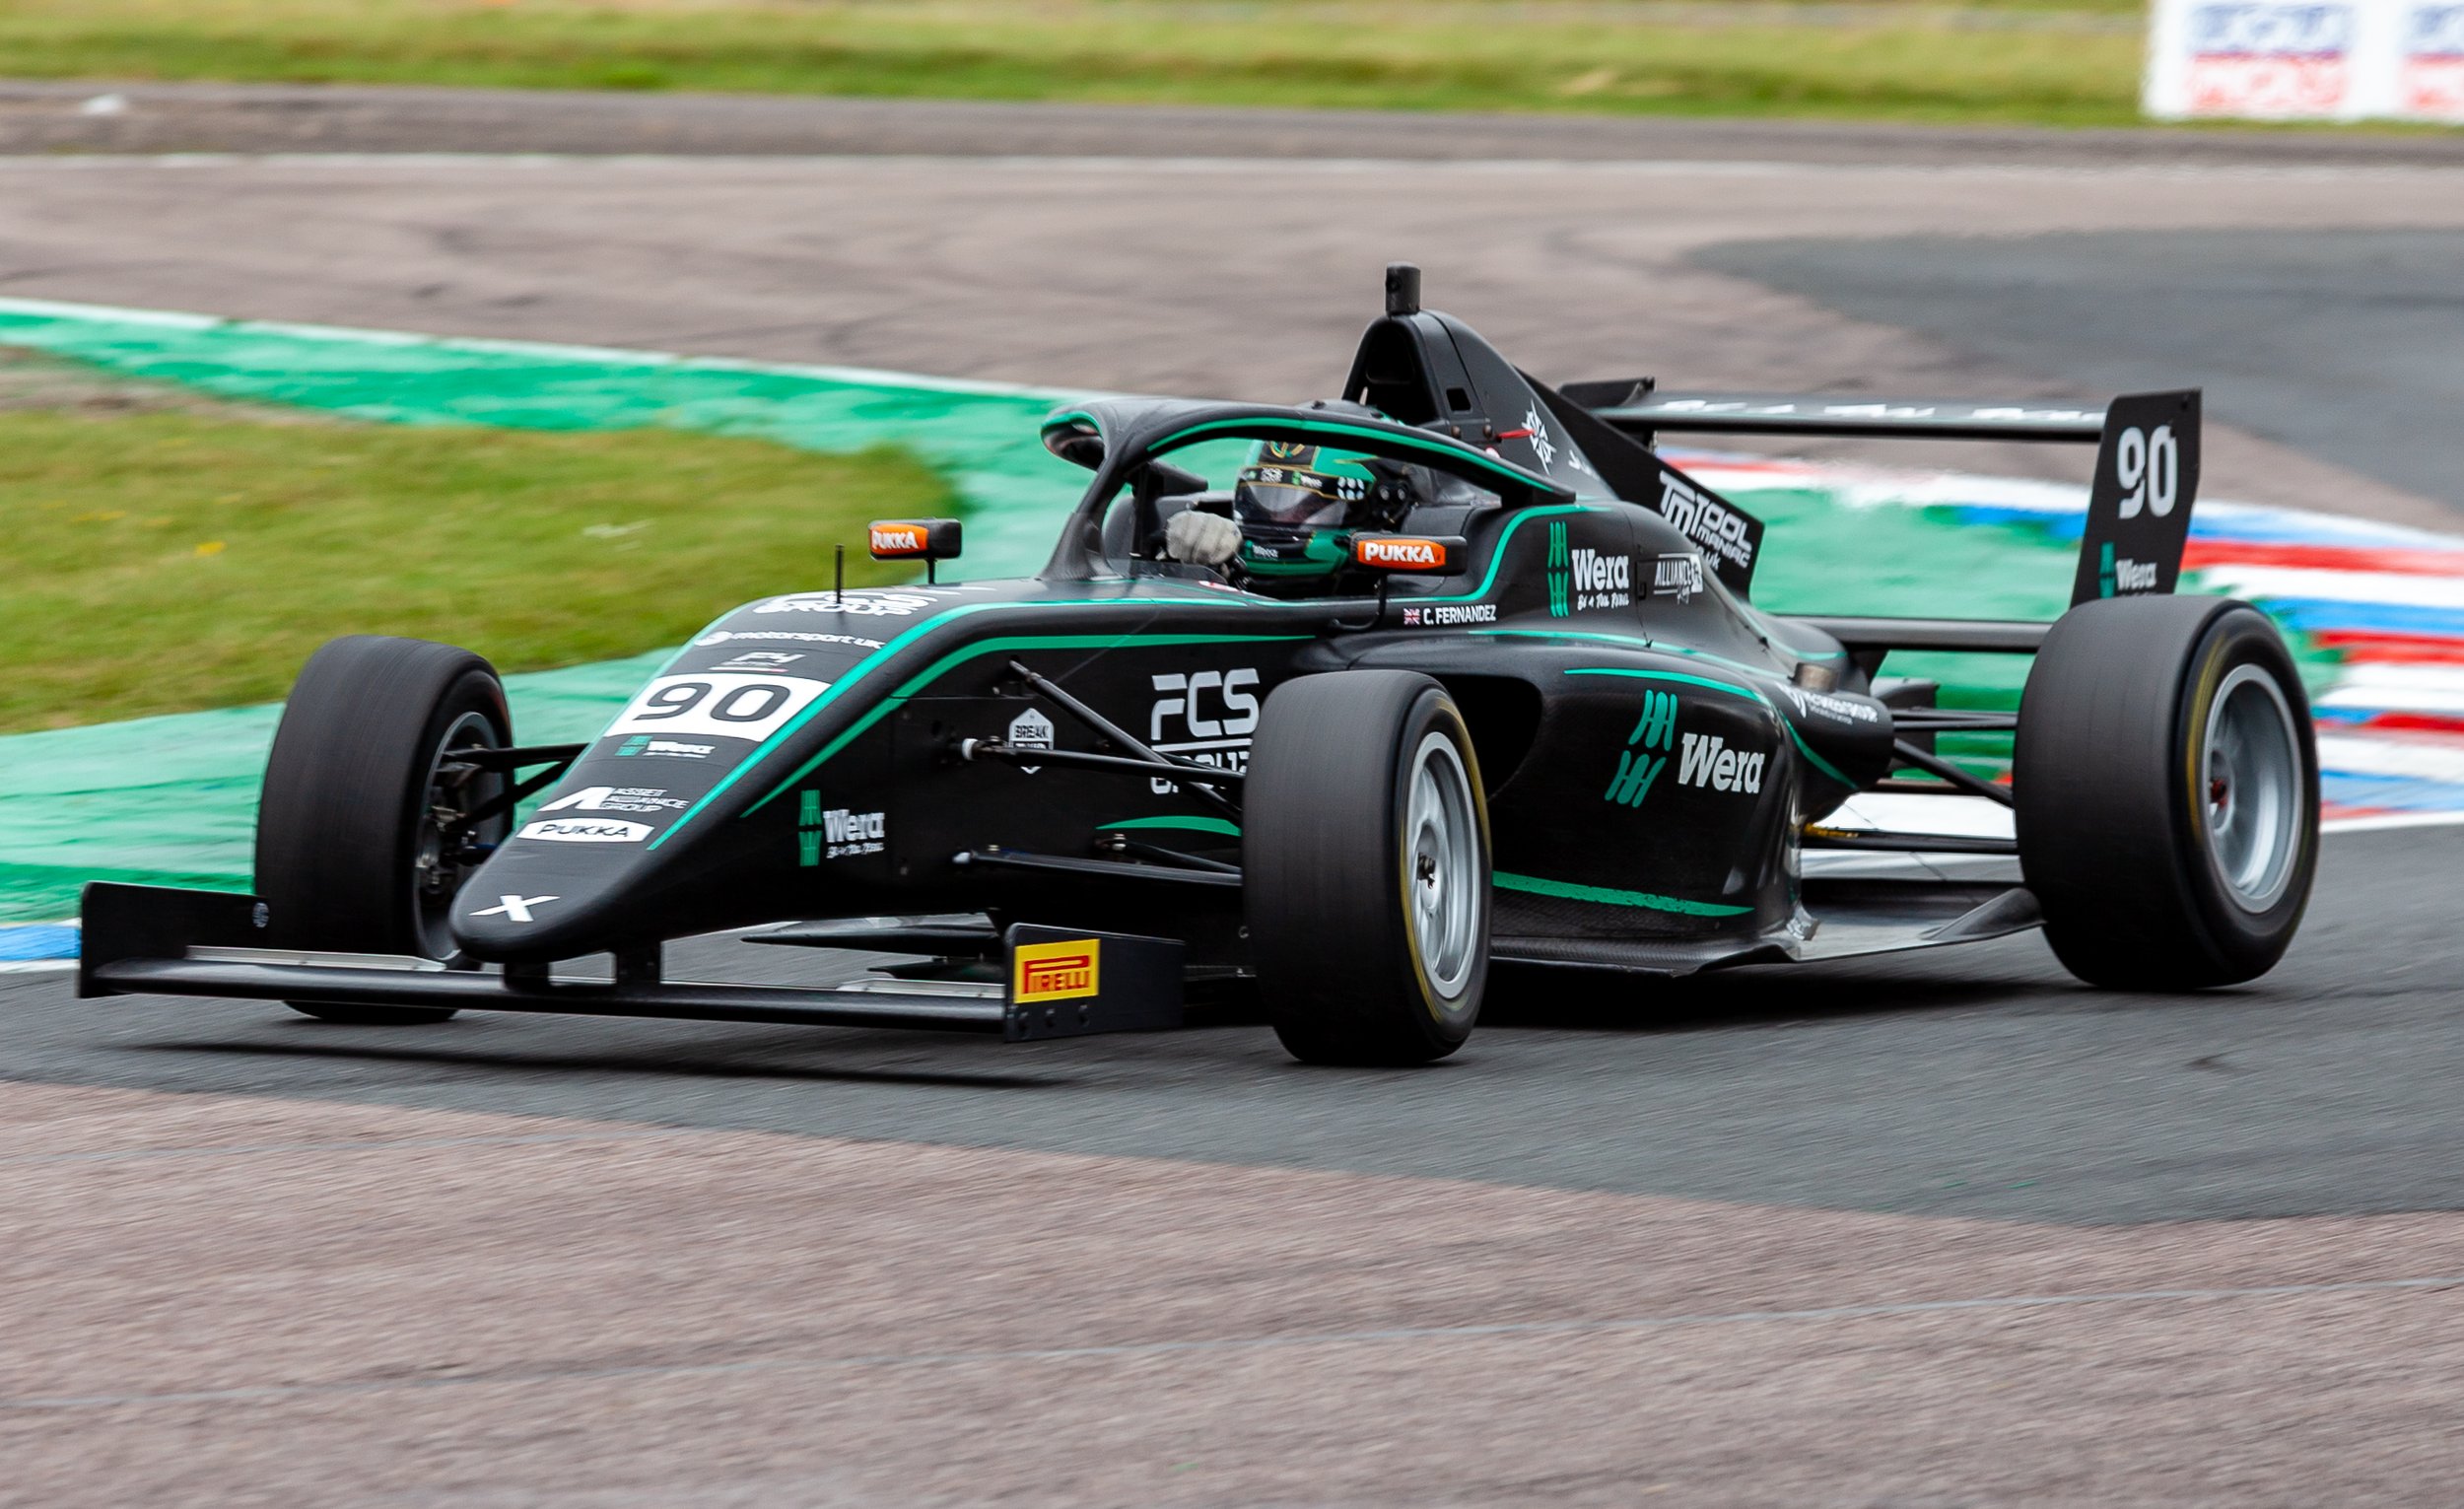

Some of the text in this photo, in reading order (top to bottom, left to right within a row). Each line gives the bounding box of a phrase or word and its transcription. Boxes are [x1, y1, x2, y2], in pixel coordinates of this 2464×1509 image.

[2117, 425, 2178, 519] 90
[871, 530, 919, 550] PUKKA
[1365, 542, 1436, 564] PUKKA
[1572, 548, 1630, 591] Wera
[2116, 559, 2158, 590] Wera
[1423, 604, 1497, 626] C. FERNANDEZ
[632, 681, 791, 722] 90
[1150, 667, 1261, 741] FCS
[1677, 731, 1766, 794] Wera
[537, 823, 630, 838] PUKKA
[823, 808, 885, 843] Wera
[1022, 954, 1091, 995] PIRELLI
